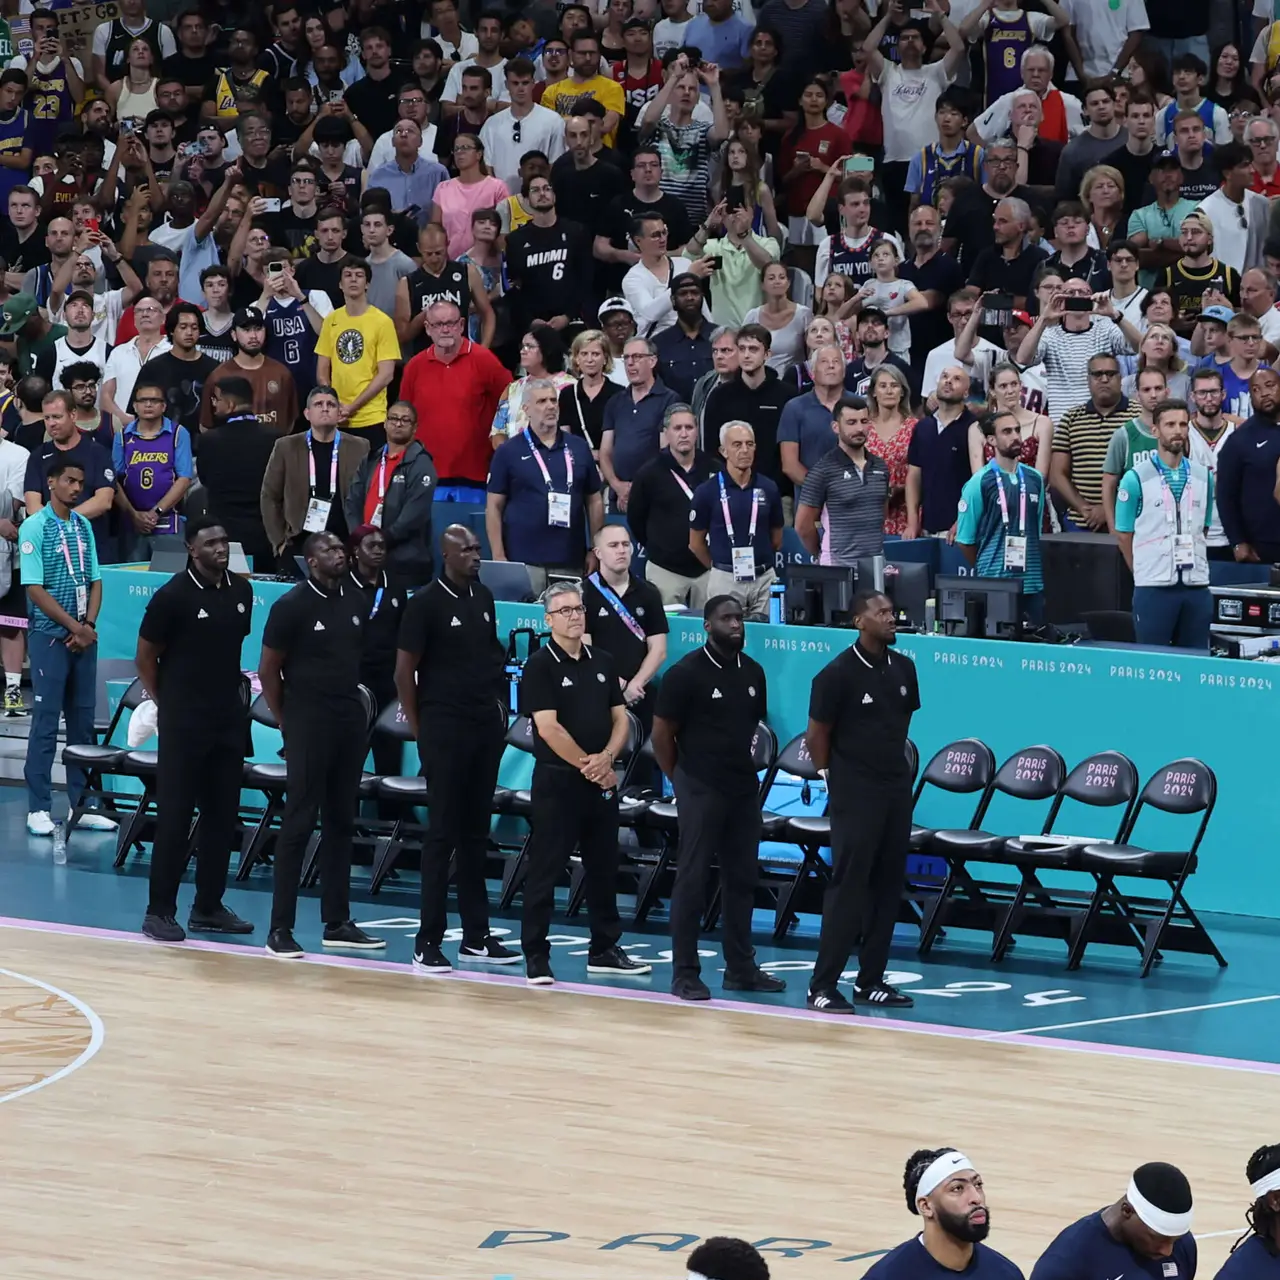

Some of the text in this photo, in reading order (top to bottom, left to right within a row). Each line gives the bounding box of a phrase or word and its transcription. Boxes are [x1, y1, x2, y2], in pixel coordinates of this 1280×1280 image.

[1003, 47, 1016, 69] 6
[33, 94, 60, 120] 23
[526, 247, 568, 268] MIAMI
[552, 262, 564, 281] 6
[832, 263, 854, 276] NEW
[273, 313, 305, 338] USA
[284, 340, 300, 364] 6
[129, 450, 169, 465] LAKERS
[140, 467, 154, 490] 6
[800, 640, 831, 653] 2024
[972, 654, 1004, 669] 2024
[1059, 662, 1092, 675] 2024
[1149, 668, 1181, 683] 2024
[1239, 675, 1273, 691] 2024
[944, 763, 974, 777] 2024
[1014, 769, 1044, 782] 2024
[1085, 775, 1116, 789] 2024
[1163, 783, 1194, 797] 2024
